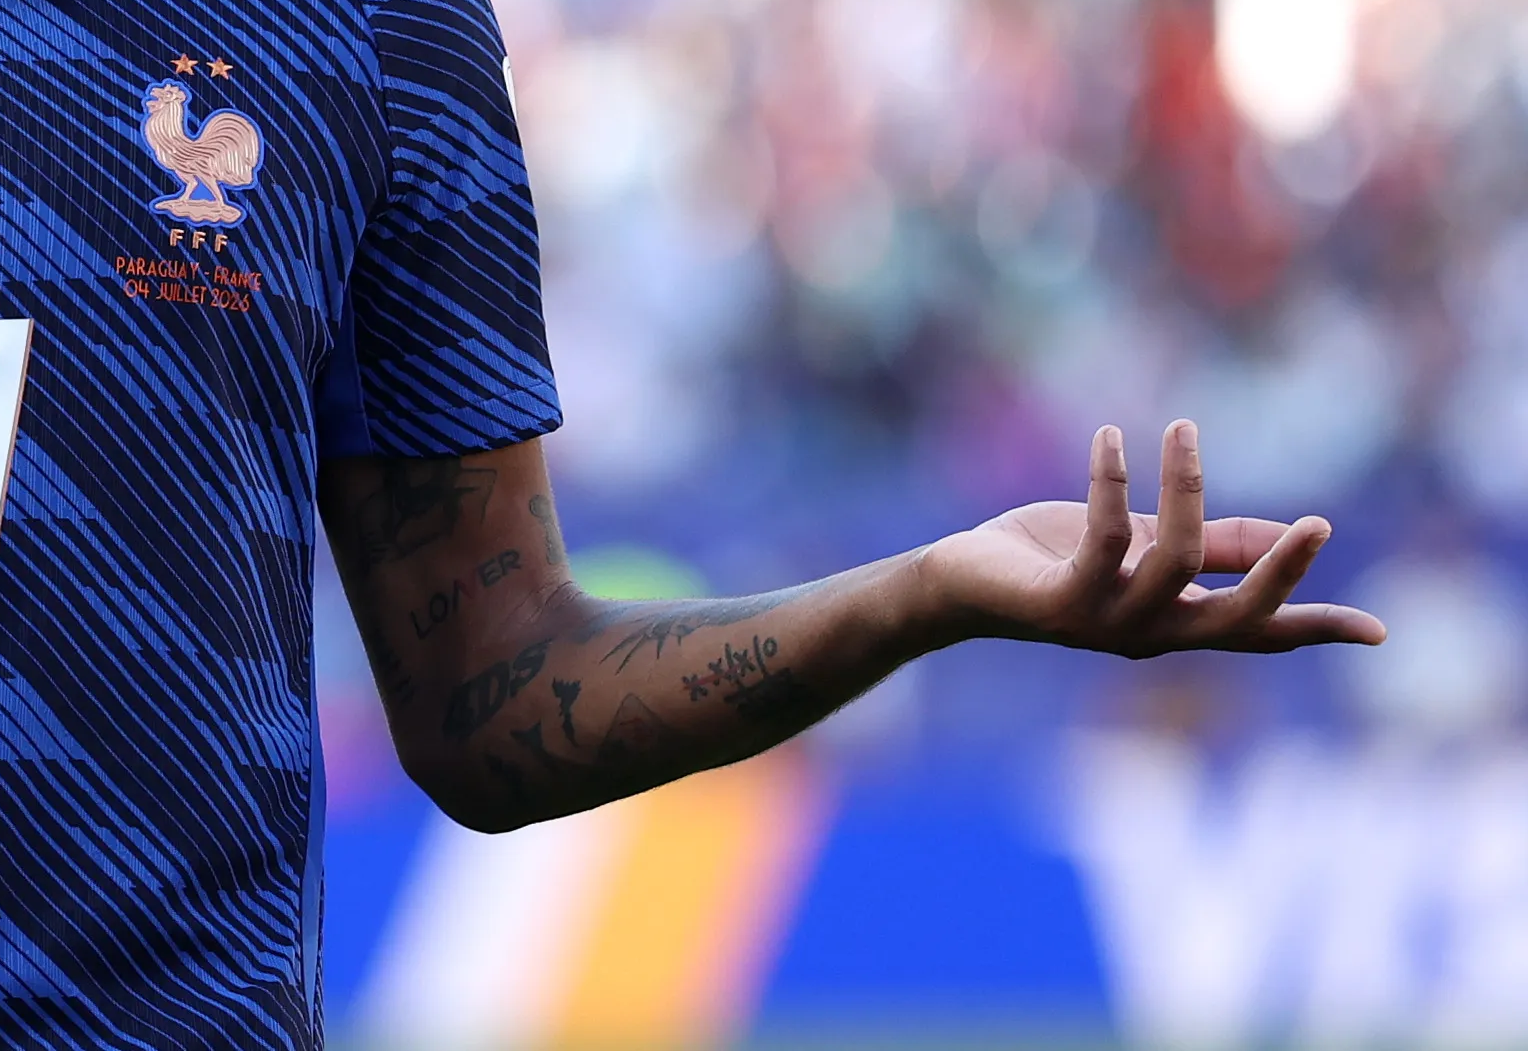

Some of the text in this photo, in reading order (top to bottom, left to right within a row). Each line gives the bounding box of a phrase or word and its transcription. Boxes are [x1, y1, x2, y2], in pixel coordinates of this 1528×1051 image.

[116, 256, 199, 280] PARAGUAY
[214, 265, 262, 291] FRANCE
[124, 279, 250, 312] 04 JUILLET 2026
